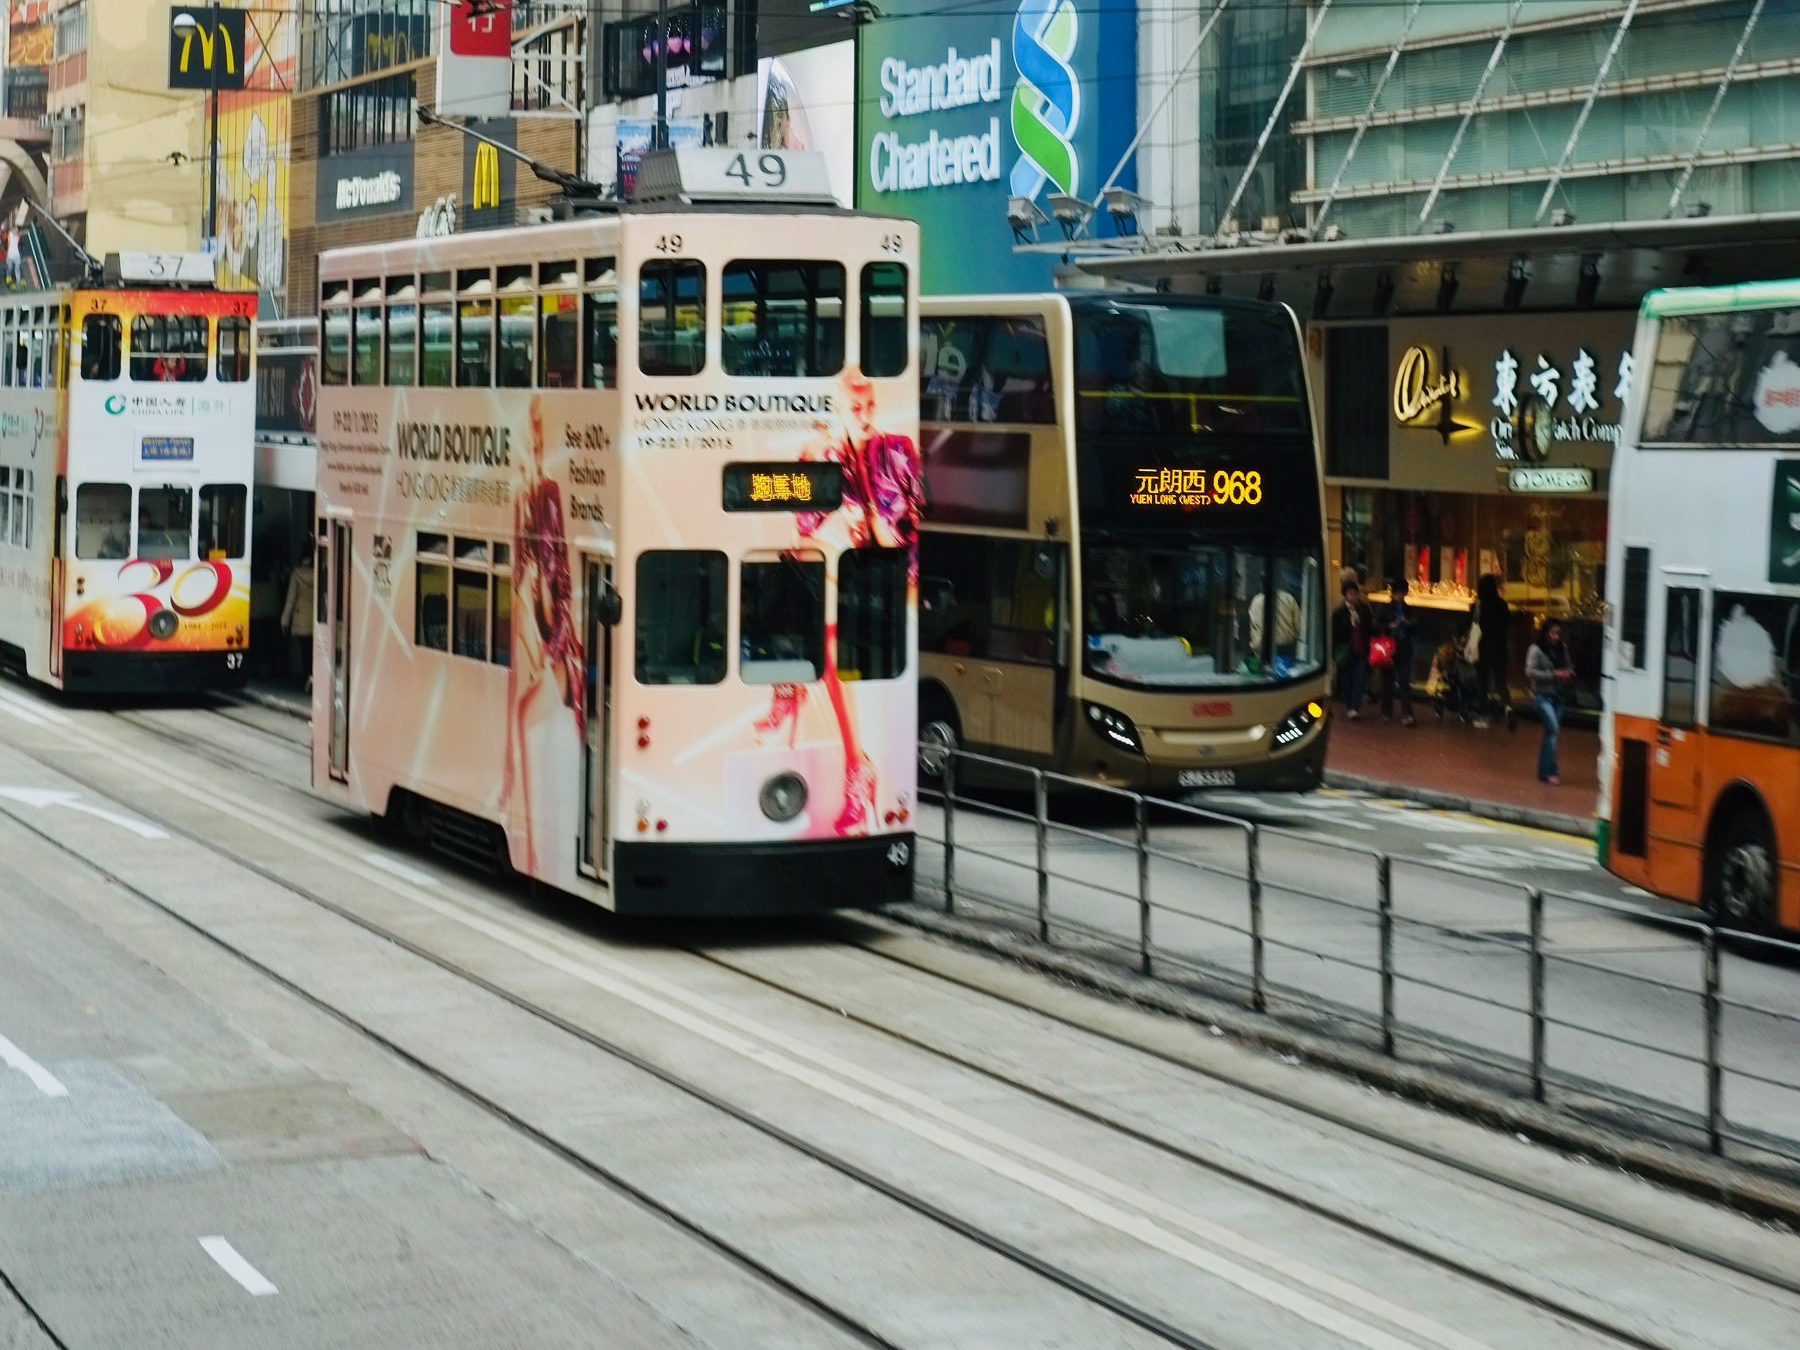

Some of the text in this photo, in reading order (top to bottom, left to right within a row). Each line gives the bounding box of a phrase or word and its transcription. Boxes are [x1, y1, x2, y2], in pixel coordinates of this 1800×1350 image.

[880, 37, 1000, 118] Standard
[870, 117, 1000, 193] Chartered
[725, 153, 786, 187] 49
[336, 170, 401, 210] McDonald's
[655, 234, 683, 254] 49
[880, 234, 903, 253] 49
[148, 255, 184, 277] 37
[90, 298, 107, 312] 37
[233, 301, 249, 314] 37
[634, 394, 833, 413] WORLD BOUTIQUE
[633, 416, 683, 431] HONG
[686, 416, 734, 431] KONG
[396, 421, 441, 461] WORLD
[444, 423, 511, 467] BOUTIQUE
[568, 456, 607, 487] Fashion
[1135, 467, 1206, 494] 元朗西
[1531, 472, 1589, 488] OMEGA
[1213, 470, 1262, 505] 968
[1130, 494, 1211, 505] YUEN LONG (WEST)
[227, 653, 243, 669] 37
[887, 841, 909, 866] 49
